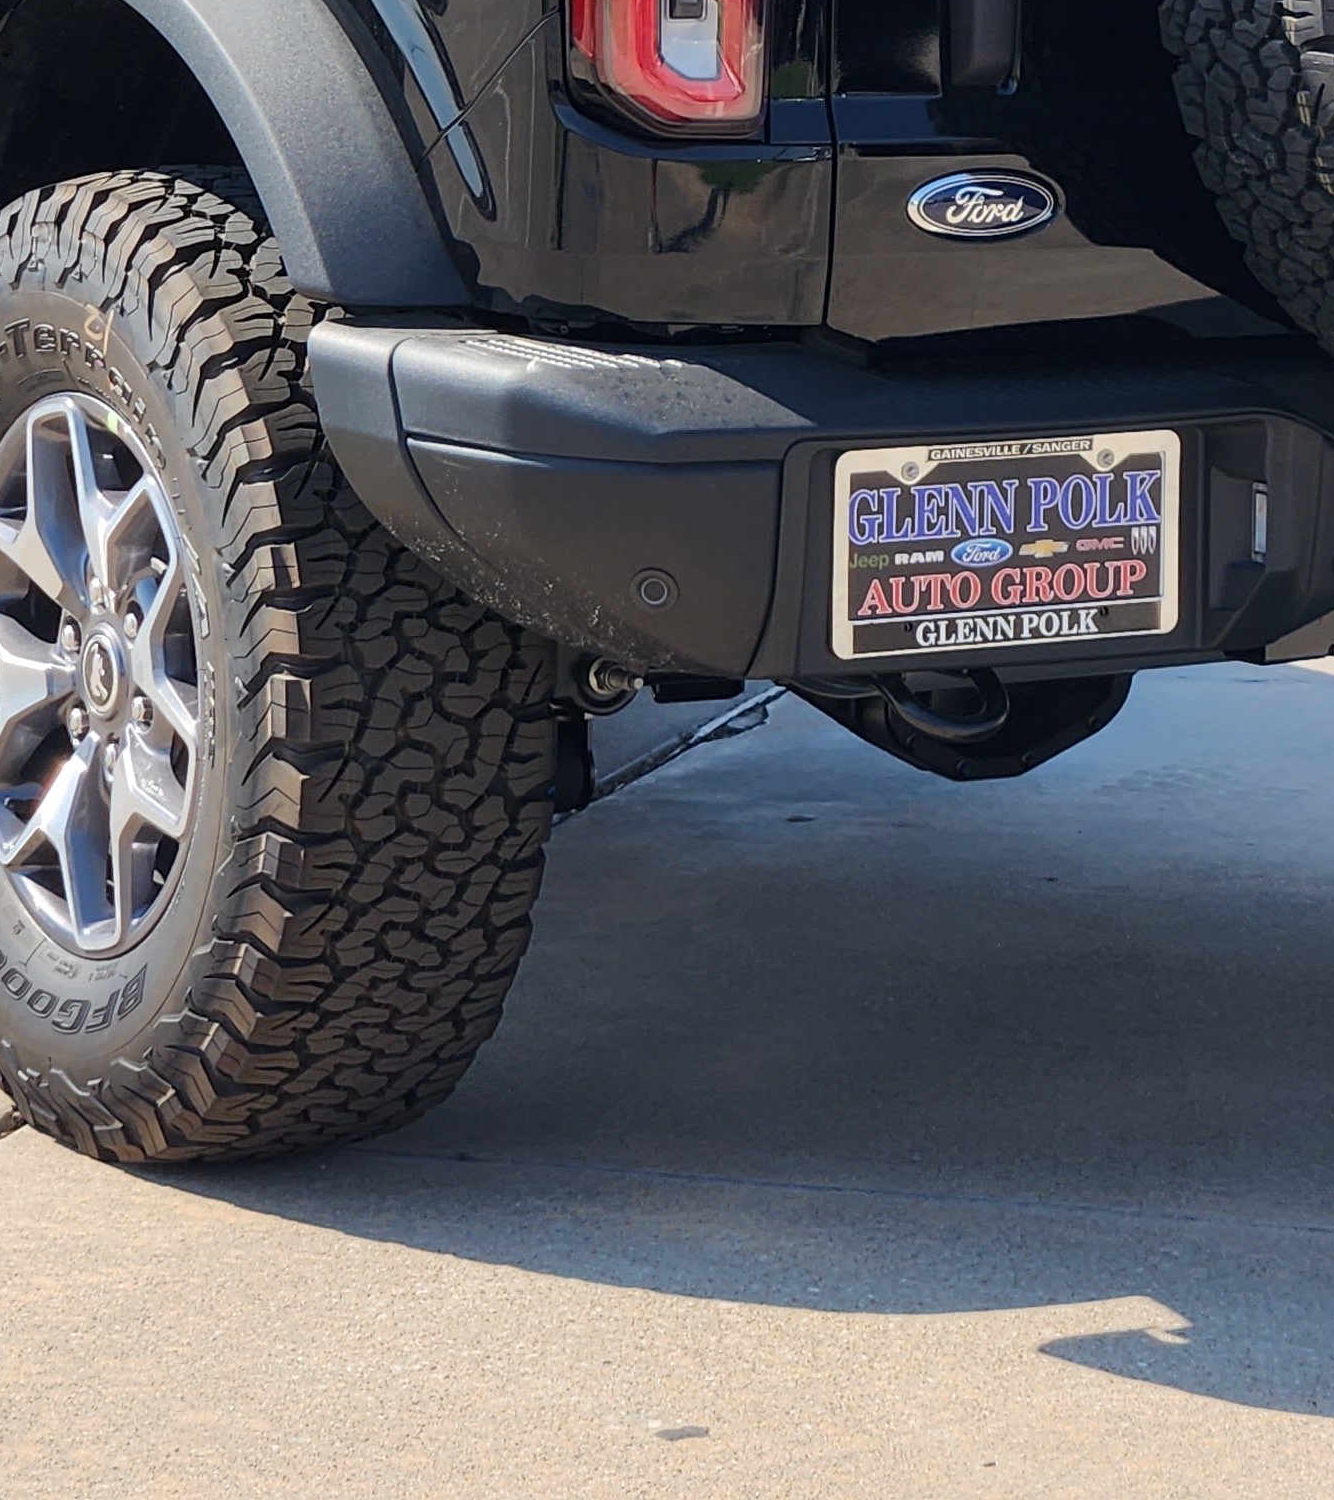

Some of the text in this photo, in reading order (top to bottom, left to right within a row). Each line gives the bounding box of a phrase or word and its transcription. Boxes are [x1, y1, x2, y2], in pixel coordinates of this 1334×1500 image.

[945, 186, 1025, 224] Ford
[847, 469, 1162, 546] GLENN POLK
[849, 536, 1125, 570] Jeep RAM Ford GMC
[857, 559, 1147, 616] AUTO GROUP
[915, 607, 1100, 647] GLENN POLK
